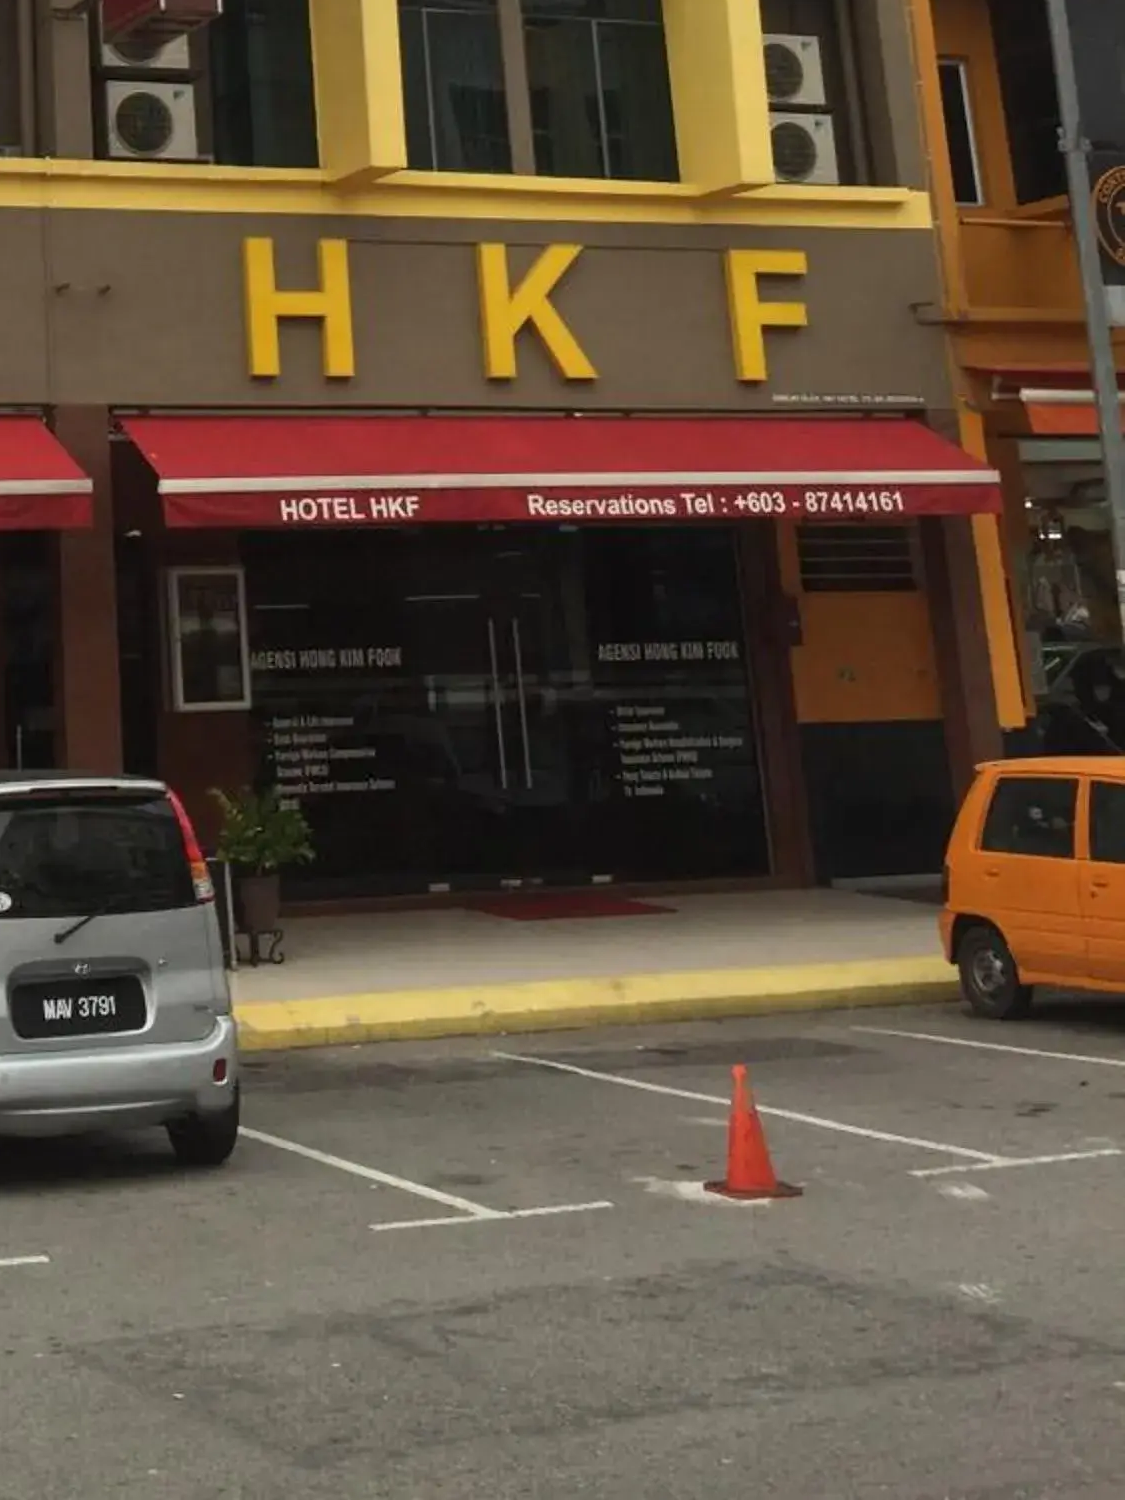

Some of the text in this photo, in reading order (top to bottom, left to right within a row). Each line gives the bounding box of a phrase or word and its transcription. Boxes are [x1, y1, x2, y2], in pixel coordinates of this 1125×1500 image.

[280, 496, 420, 521] HOTEL HKF
[527, 492, 676, 517] Reservations
[680, 493, 714, 515] Tel
[734, 491, 786, 513] +603
[805, 490, 904, 513] 87414161
[78, 995, 116, 1017] 3791
